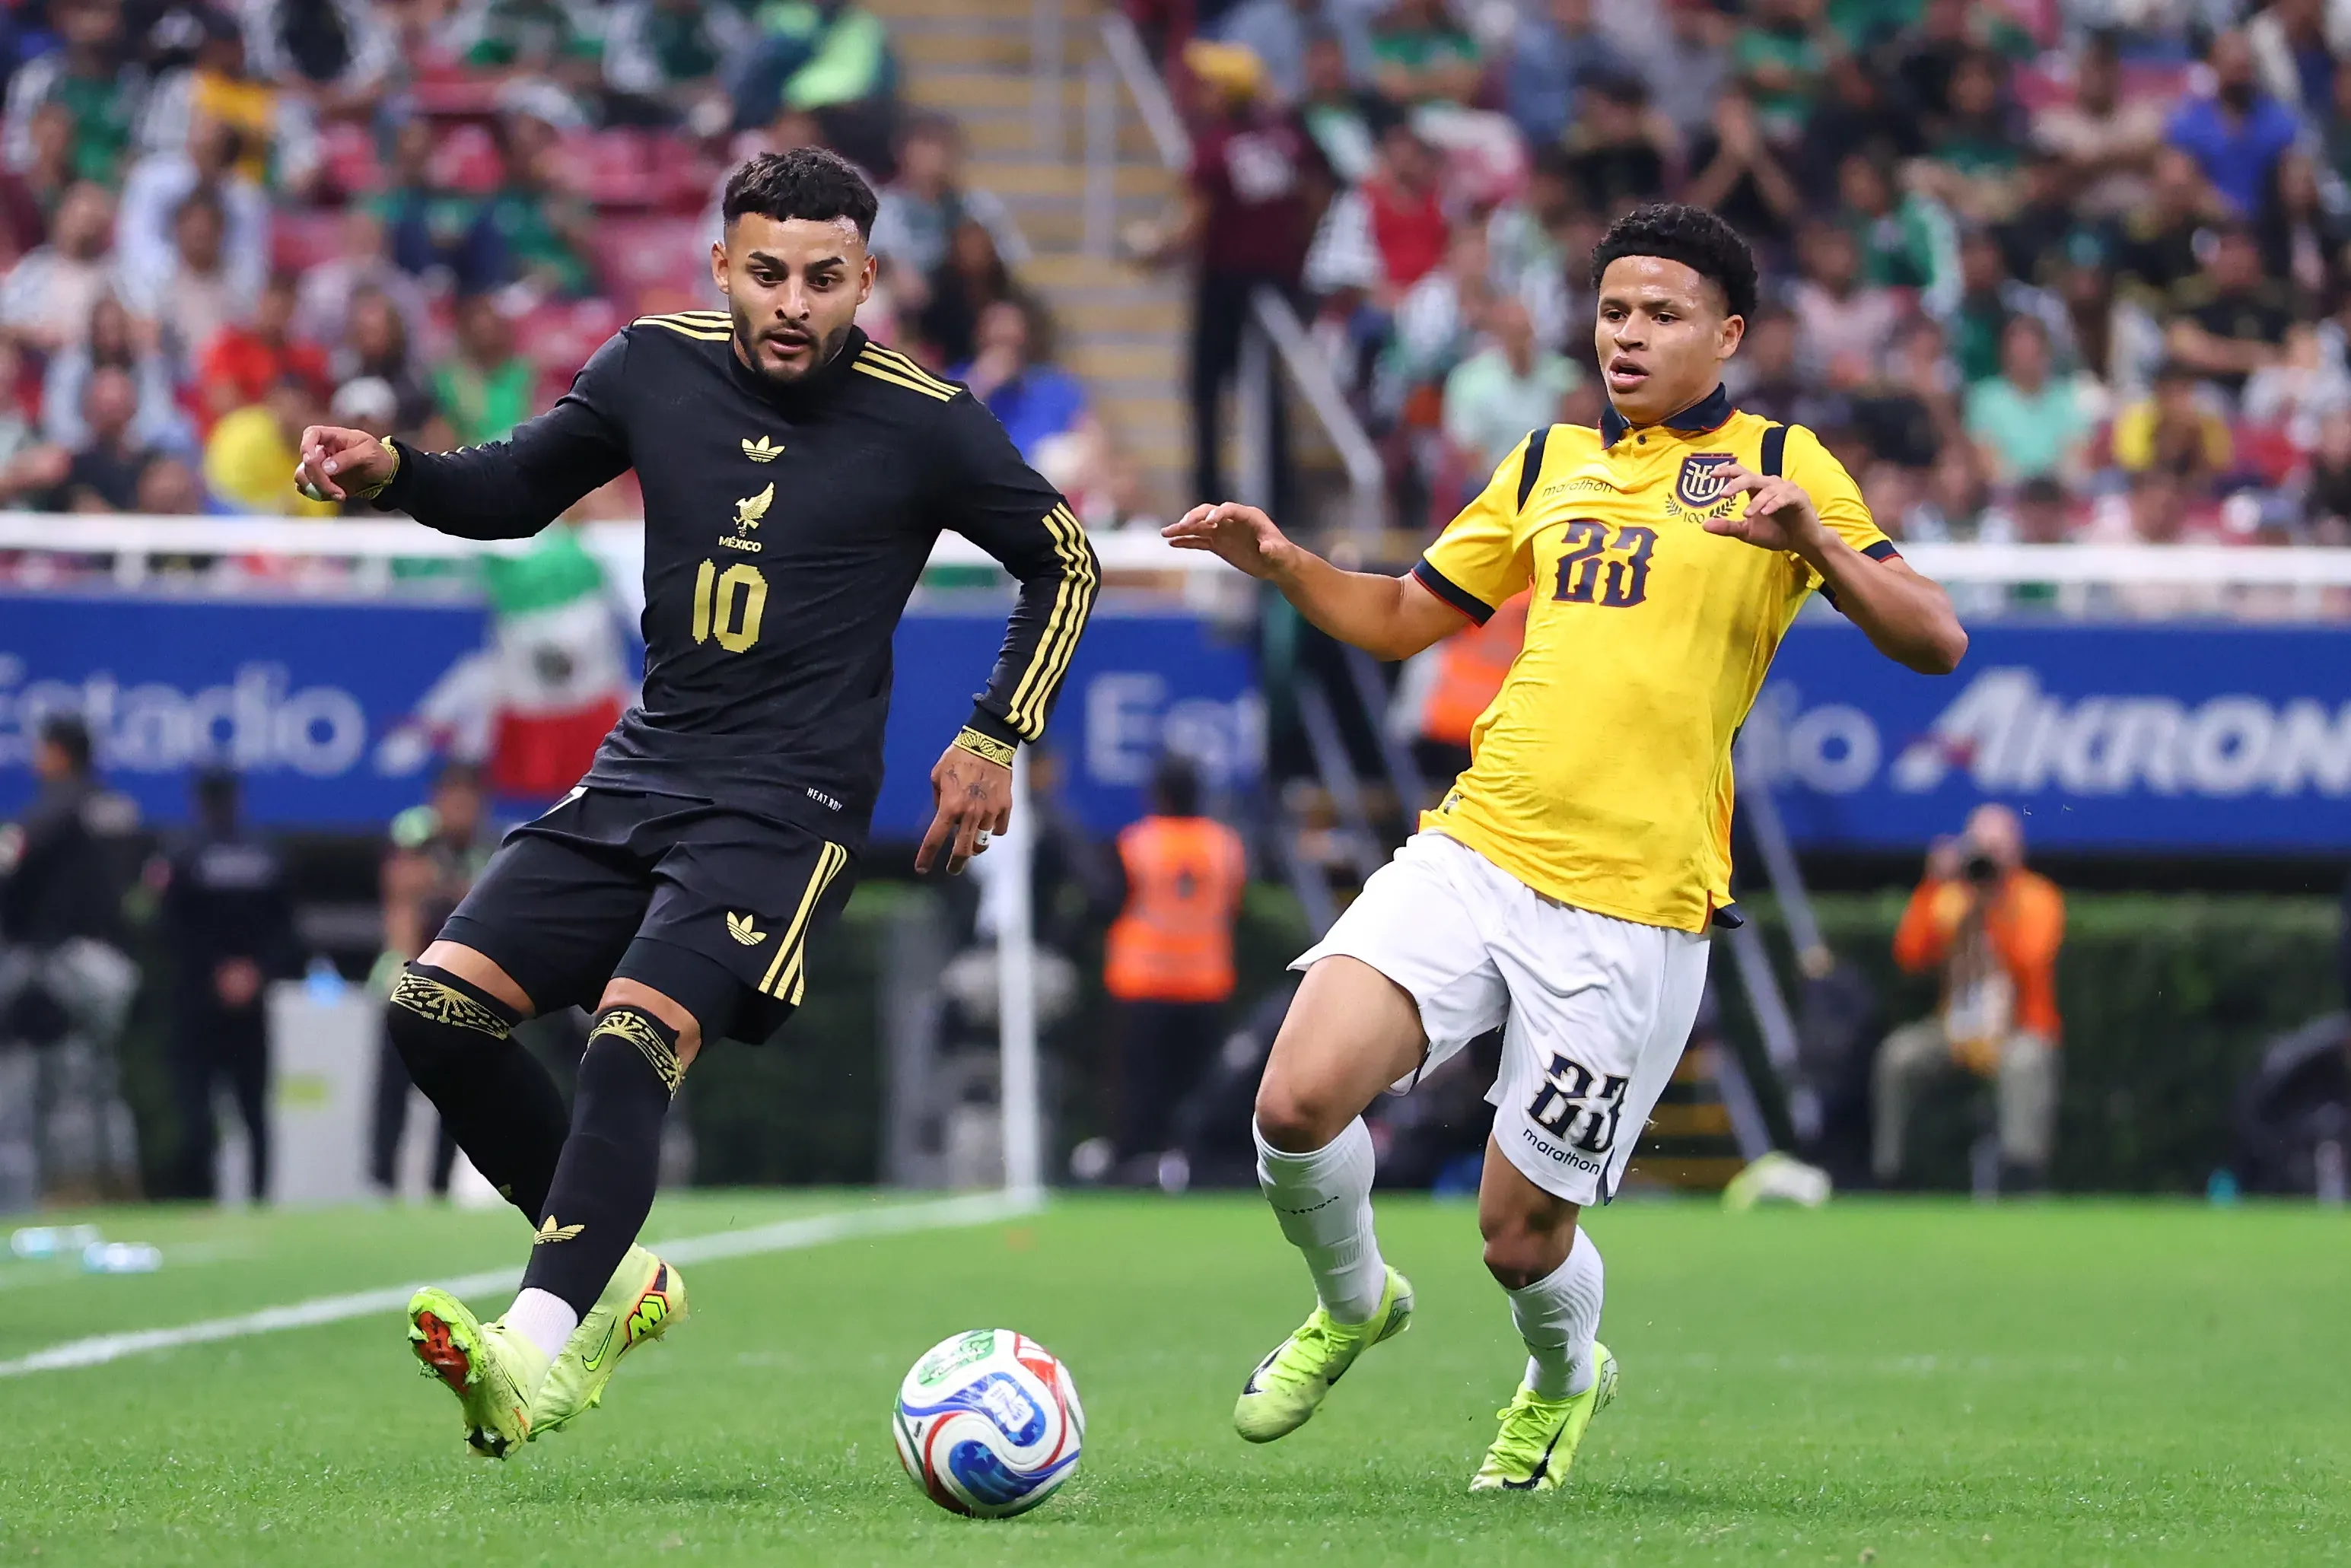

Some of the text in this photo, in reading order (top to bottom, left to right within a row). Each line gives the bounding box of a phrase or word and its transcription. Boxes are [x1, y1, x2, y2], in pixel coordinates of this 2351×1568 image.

[1542, 479, 1612, 498] marathon
[718, 536, 762, 552] MÉXICO
[1551, 518, 1659, 608] 23
[692, 558, 768, 654] 10
[1525, 1049, 1630, 1155] 23
[1523, 1128, 1600, 1175] marathon
